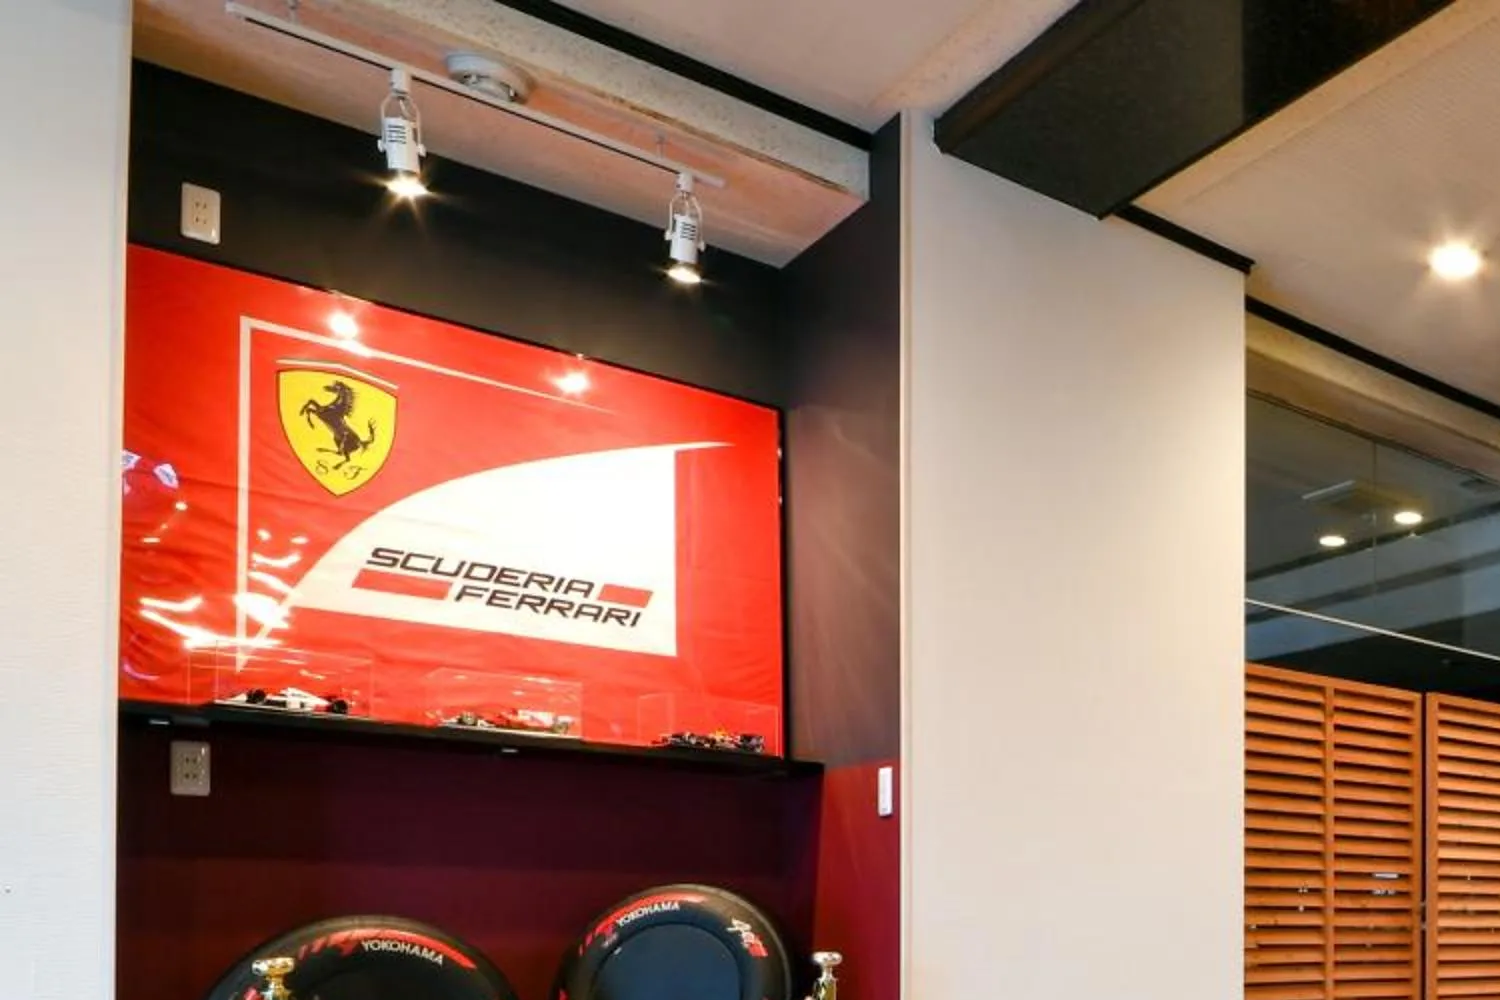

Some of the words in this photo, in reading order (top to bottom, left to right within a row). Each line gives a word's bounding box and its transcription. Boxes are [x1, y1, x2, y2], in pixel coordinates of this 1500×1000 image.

[366, 547, 595, 598] SCUDERIA
[454, 585, 641, 627] FERRARI
[615, 901, 681, 928] YOKOHAMA
[361, 939, 445, 967] YOKOHAMA
